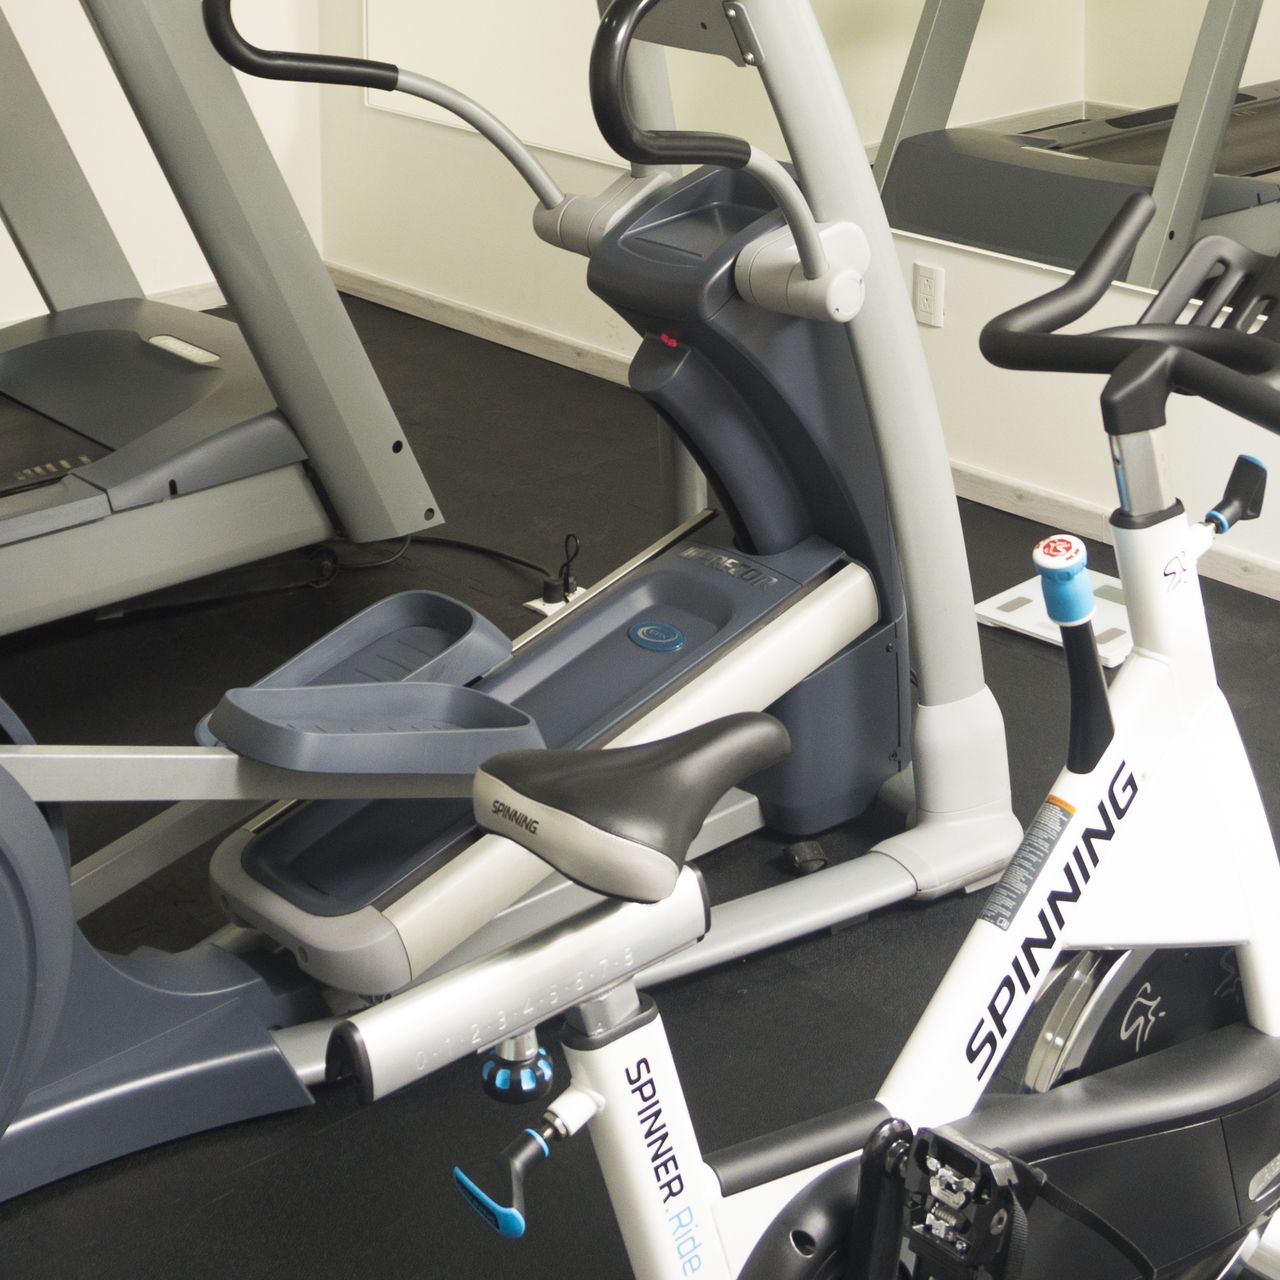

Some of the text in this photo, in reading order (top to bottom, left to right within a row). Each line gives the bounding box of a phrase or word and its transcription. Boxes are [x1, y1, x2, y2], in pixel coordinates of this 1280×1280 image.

[491, 799, 540, 835] SPINNING
[965, 759, 1139, 1083] SPINNING
[471, 1023, 482, 1044] 2
[497, 1010, 507, 1030] 3
[523, 997, 535, 1015] 4
[599, 958, 609, 978] 7
[624, 1057, 702, 1277] SPINNER Ride
